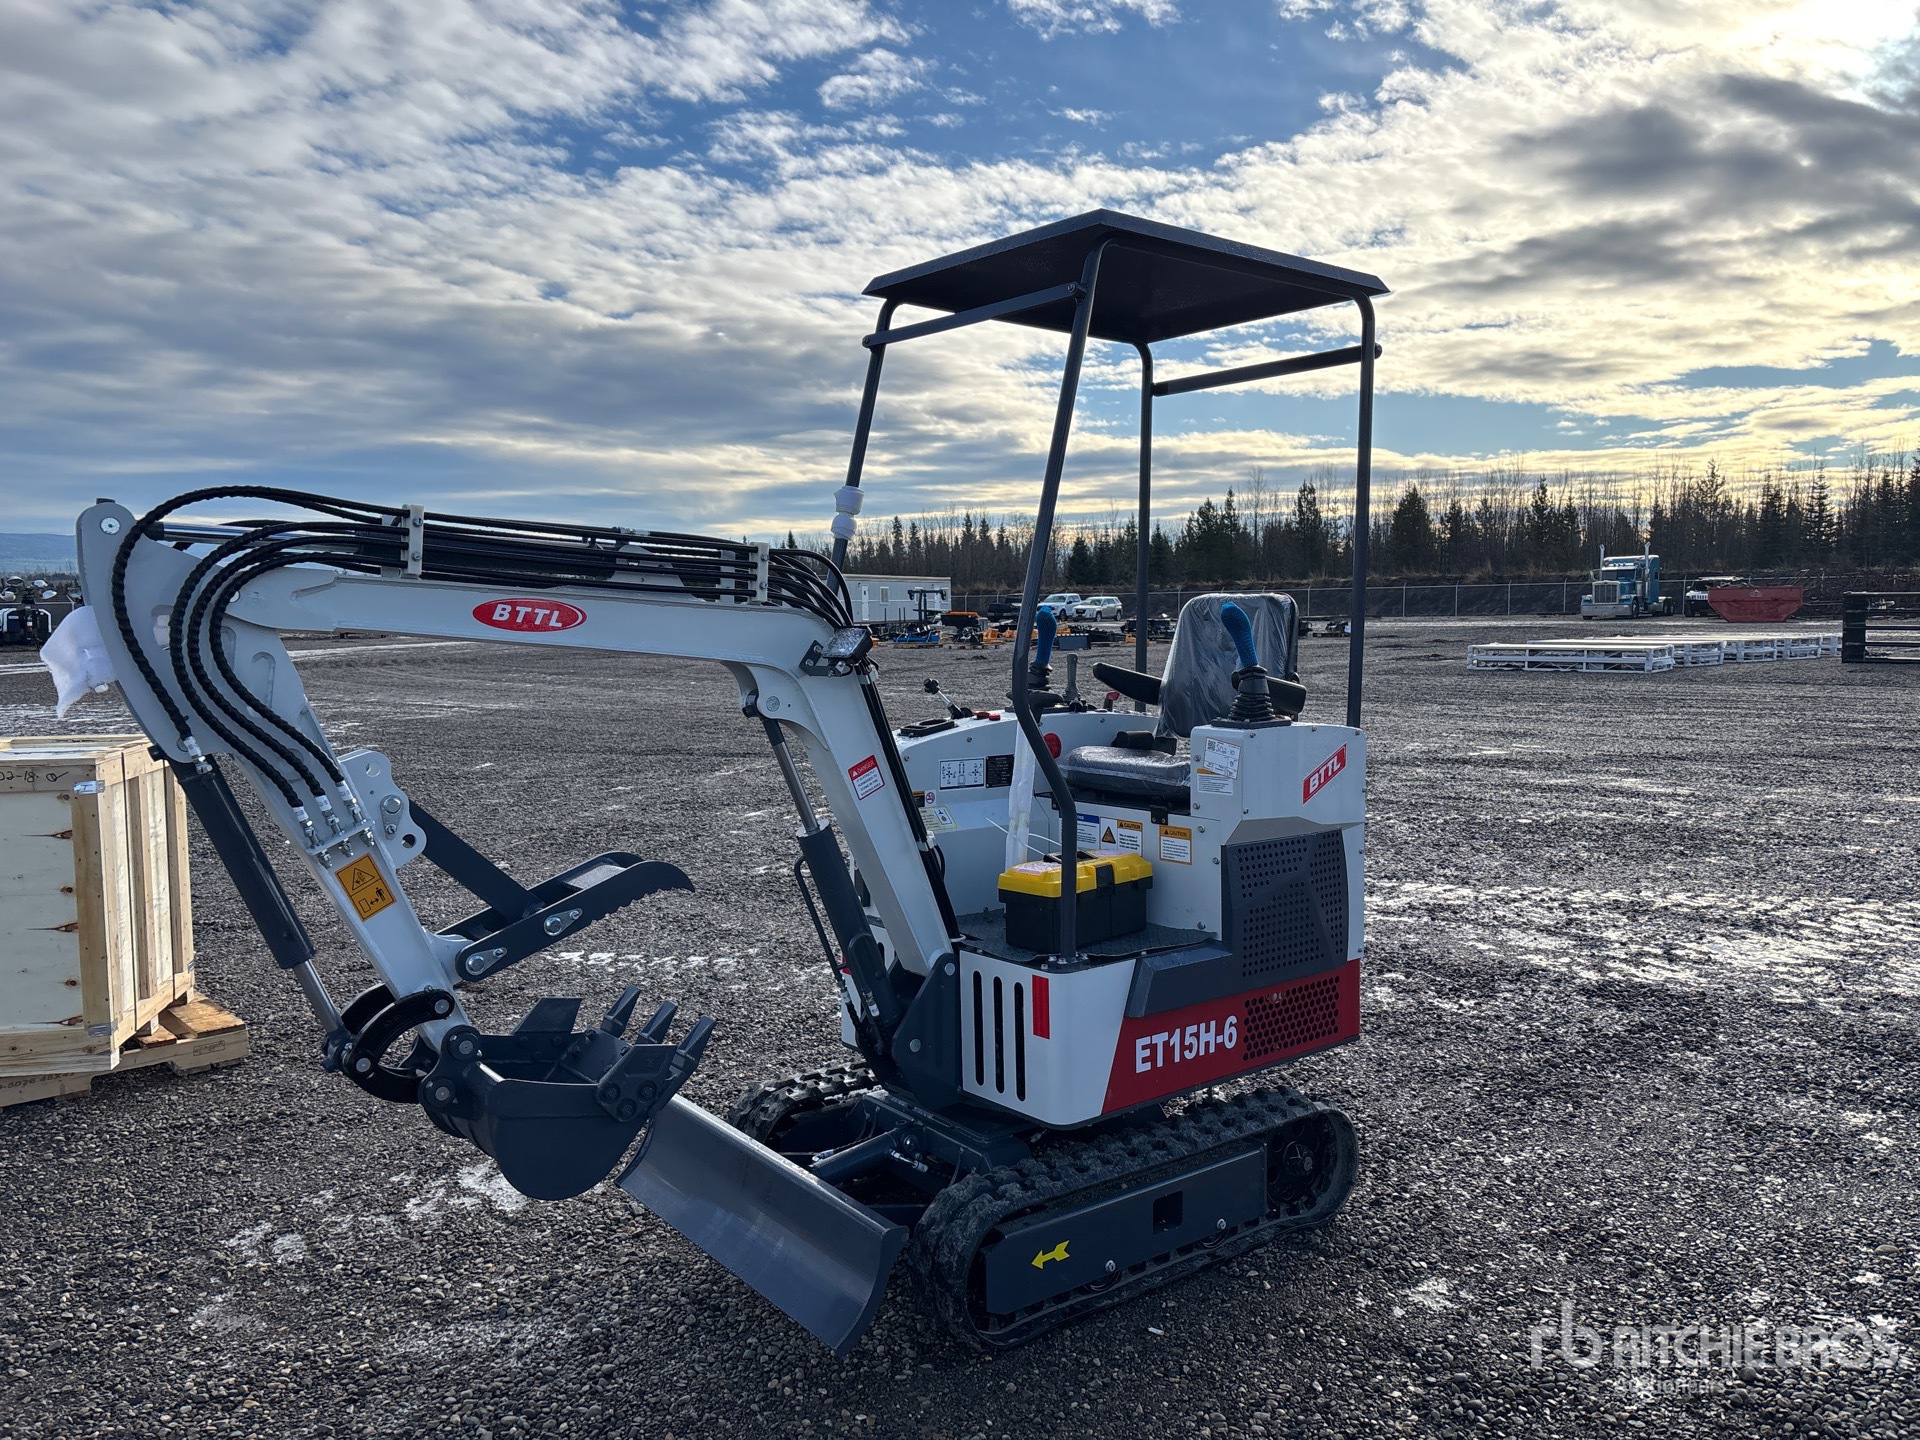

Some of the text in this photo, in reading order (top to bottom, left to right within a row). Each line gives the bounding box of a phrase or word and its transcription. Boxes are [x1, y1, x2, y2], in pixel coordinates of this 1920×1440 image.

[492, 603, 563, 628] BTTL
[856, 760, 874, 774] DANGER
[1309, 755, 1341, 794] BTTL
[1123, 822, 1141, 830] CAUTION
[1168, 829, 1188, 838] CAUTION
[1135, 1015, 1238, 1074] ET15H-6
